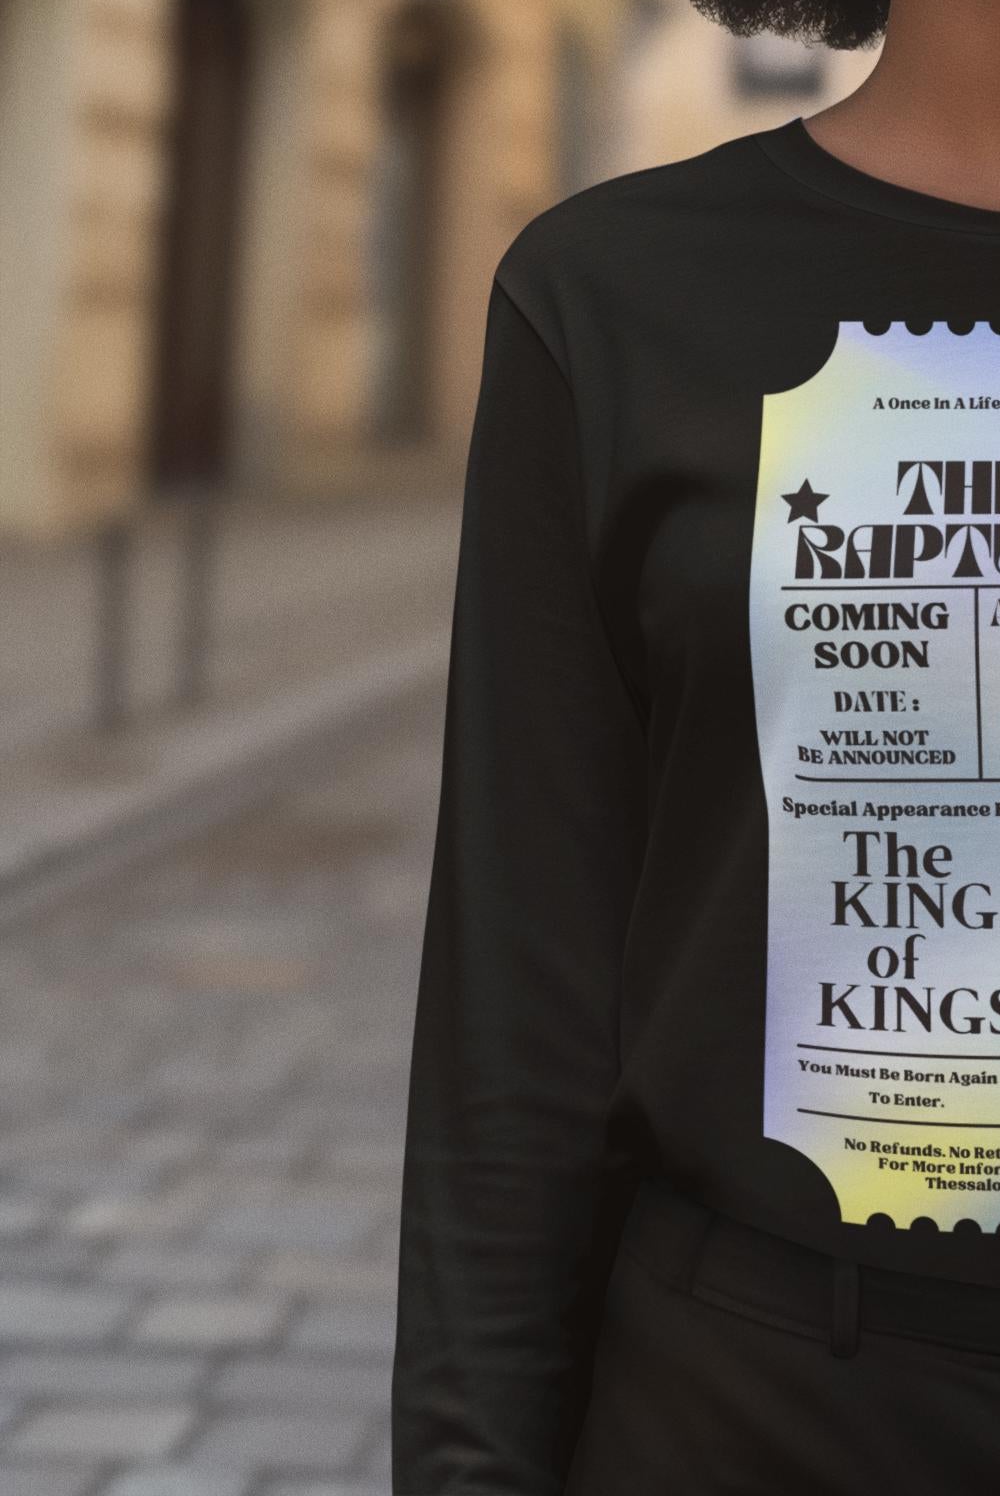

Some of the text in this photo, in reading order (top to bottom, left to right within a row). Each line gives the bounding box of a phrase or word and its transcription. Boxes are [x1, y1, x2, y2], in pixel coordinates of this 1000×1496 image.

[873, 397, 885, 410] A
[888, 397, 931, 410] Once
[934, 397, 951, 410] In
[954, 397, 966, 410] A
[784, 602, 950, 632] COMING
[813, 640, 930, 670] SOON
[819, 729, 930, 747] WILL NOT
[797, 745, 957, 766] BE ANNOUNCED
[782, 796, 858, 819] Special
[862, 801, 991, 822] Appearance
[842, 830, 953, 879] The
[830, 880, 999, 930] KING
[867, 933, 927, 980] of
[797, 1059, 998, 1087] You Must Be Born Again
[868, 1091, 945, 1108] To Enter.
[844, 1137, 867, 1152] No
[870, 1140, 946, 1158] Refunds.
[949, 1146, 971, 1159] No
[878, 1157, 909, 1171] For
[912, 1160, 956, 1174] More
